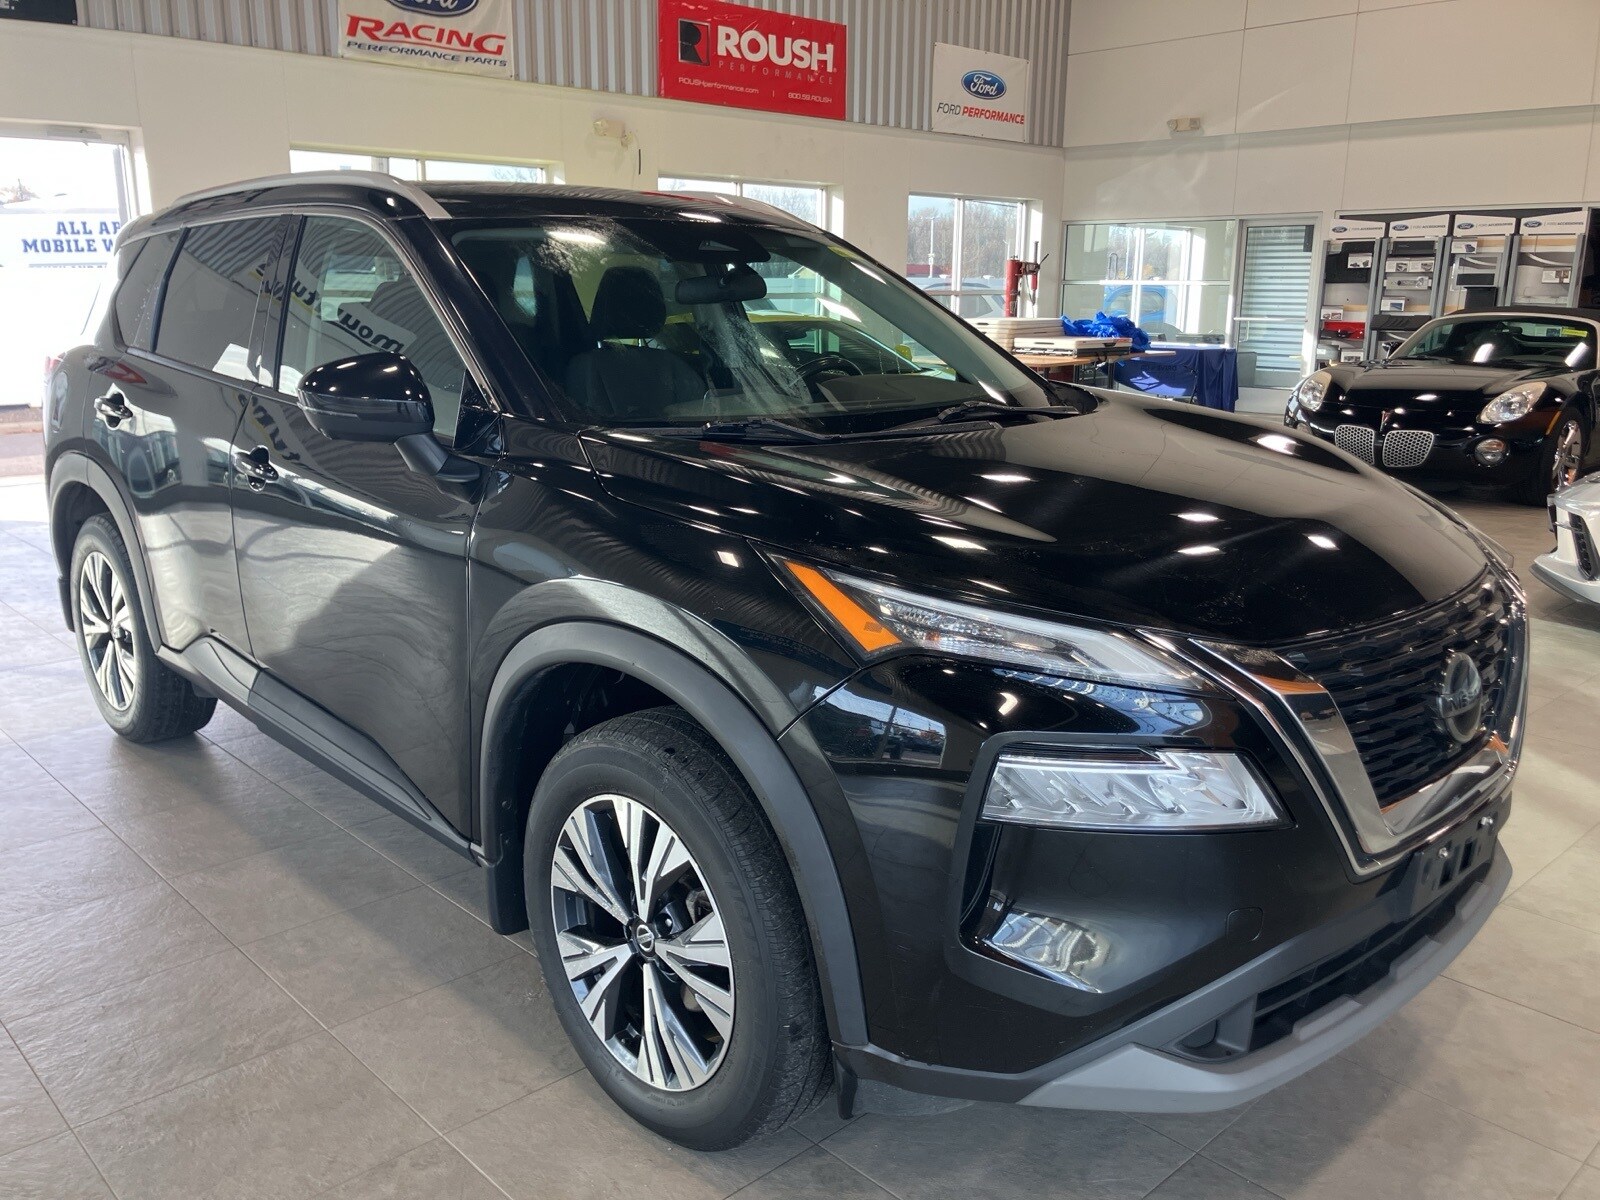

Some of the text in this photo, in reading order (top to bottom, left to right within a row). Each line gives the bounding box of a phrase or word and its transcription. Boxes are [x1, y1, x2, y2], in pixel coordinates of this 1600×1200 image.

[346, 14, 507, 56] RACING
[346, 40, 508, 68] PERFORMANCE PARTS
[717, 25, 834, 73] ROUSH
[718, 60, 834, 85] PERFORMANCE
[969, 74, 998, 96] Ford
[936, 102, 1025, 125] FORD PERFORMANCE
[56, 221, 93, 235] ALL
[21, 239, 97, 253] MOBILE
